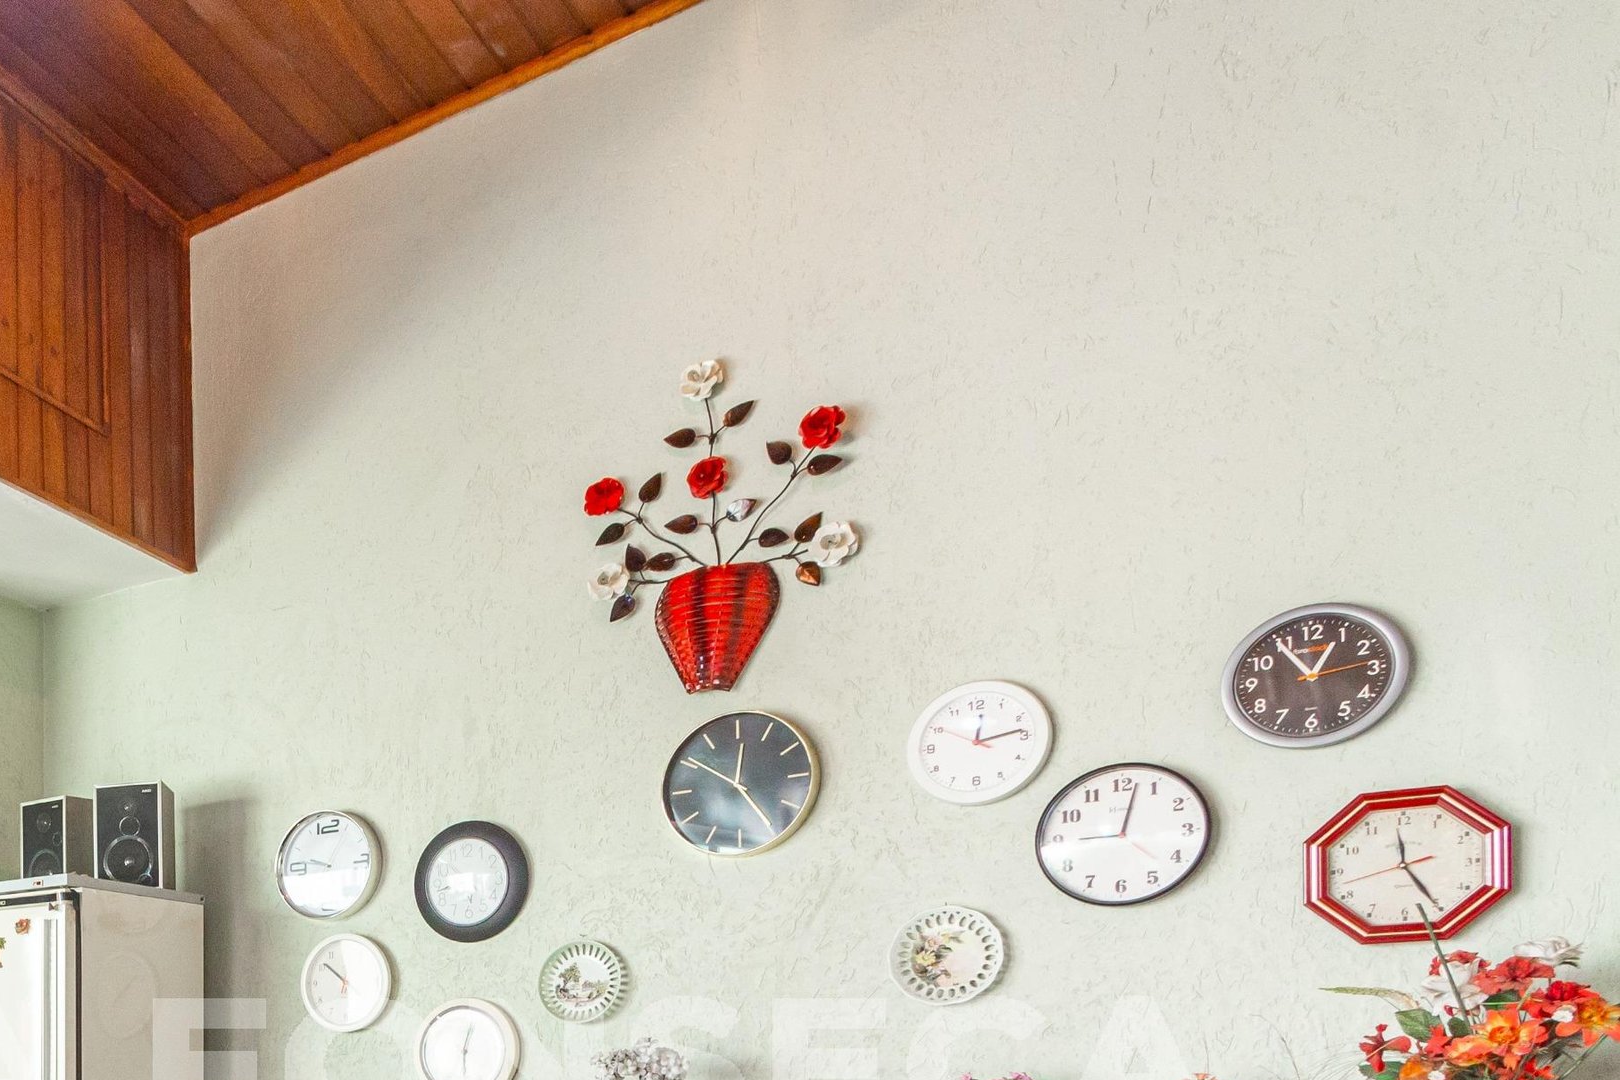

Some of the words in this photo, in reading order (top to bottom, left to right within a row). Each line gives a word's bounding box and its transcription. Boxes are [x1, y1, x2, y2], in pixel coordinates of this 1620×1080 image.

[1302, 624, 1324, 642] 12
[1338, 627, 1346, 643] 1
[1356, 640, 1371, 656] 2
[1252, 655, 1274, 672] 10
[1366, 660, 1380, 676] 3
[1245, 678, 1258, 693] 9
[1357, 683, 1371, 699] 4
[949, 708, 959, 717] 11
[967, 699, 985, 711] 12
[1254, 698, 1266, 714] 8
[1337, 700, 1351, 717] 5
[1015, 714, 1022, 722] 2
[1275, 708, 1290, 725] 7
[1304, 713, 1318, 729] 6
[933, 726, 944, 735] 10
[1019, 729, 1029, 741] 3
[926, 743, 936, 755] 9
[932, 764, 940, 773] 8
[997, 771, 1003, 779] 5
[971, 775, 981, 787] 6
[1112, 777, 1133, 793] 12
[1149, 781, 1158, 796] 1
[1084, 788, 1100, 804] 11
[1172, 797, 1185, 812] 2
[1061, 808, 1082, 824] 10
[1396, 815, 1412, 827] 12
[316, 818, 340, 836] 12
[1181, 822, 1195, 837] 3
[1365, 825, 1378, 836] 11
[1457, 835, 1465, 845] 2
[449, 849, 457, 862] 11
[461, 843, 473, 858] 12
[1169, 848, 1182, 864] 4
[1344, 845, 1360, 856] 10
[289, 860, 307, 876] 9
[488, 854, 497, 868] 2
[1062, 858, 1074, 873] 8
[1464, 857, 1472, 868] 3
[437, 864, 449, 877] 10
[494, 870, 503, 885] 3
[1146, 870, 1160, 885] 5
[1336, 867, 1344, 877] 9
[1084, 874, 1096, 889] 7
[1114, 878, 1128, 895] 6
[438, 892, 447, 907] 8
[488, 887, 497, 902] 4
[1346, 889, 1354, 899] 8
[449, 903, 457, 916] 7
[464, 905, 474, 919] 6
[478, 898, 488, 912] 5
[1369, 903, 1376, 913] 7
[1401, 906, 1408, 917] 6
